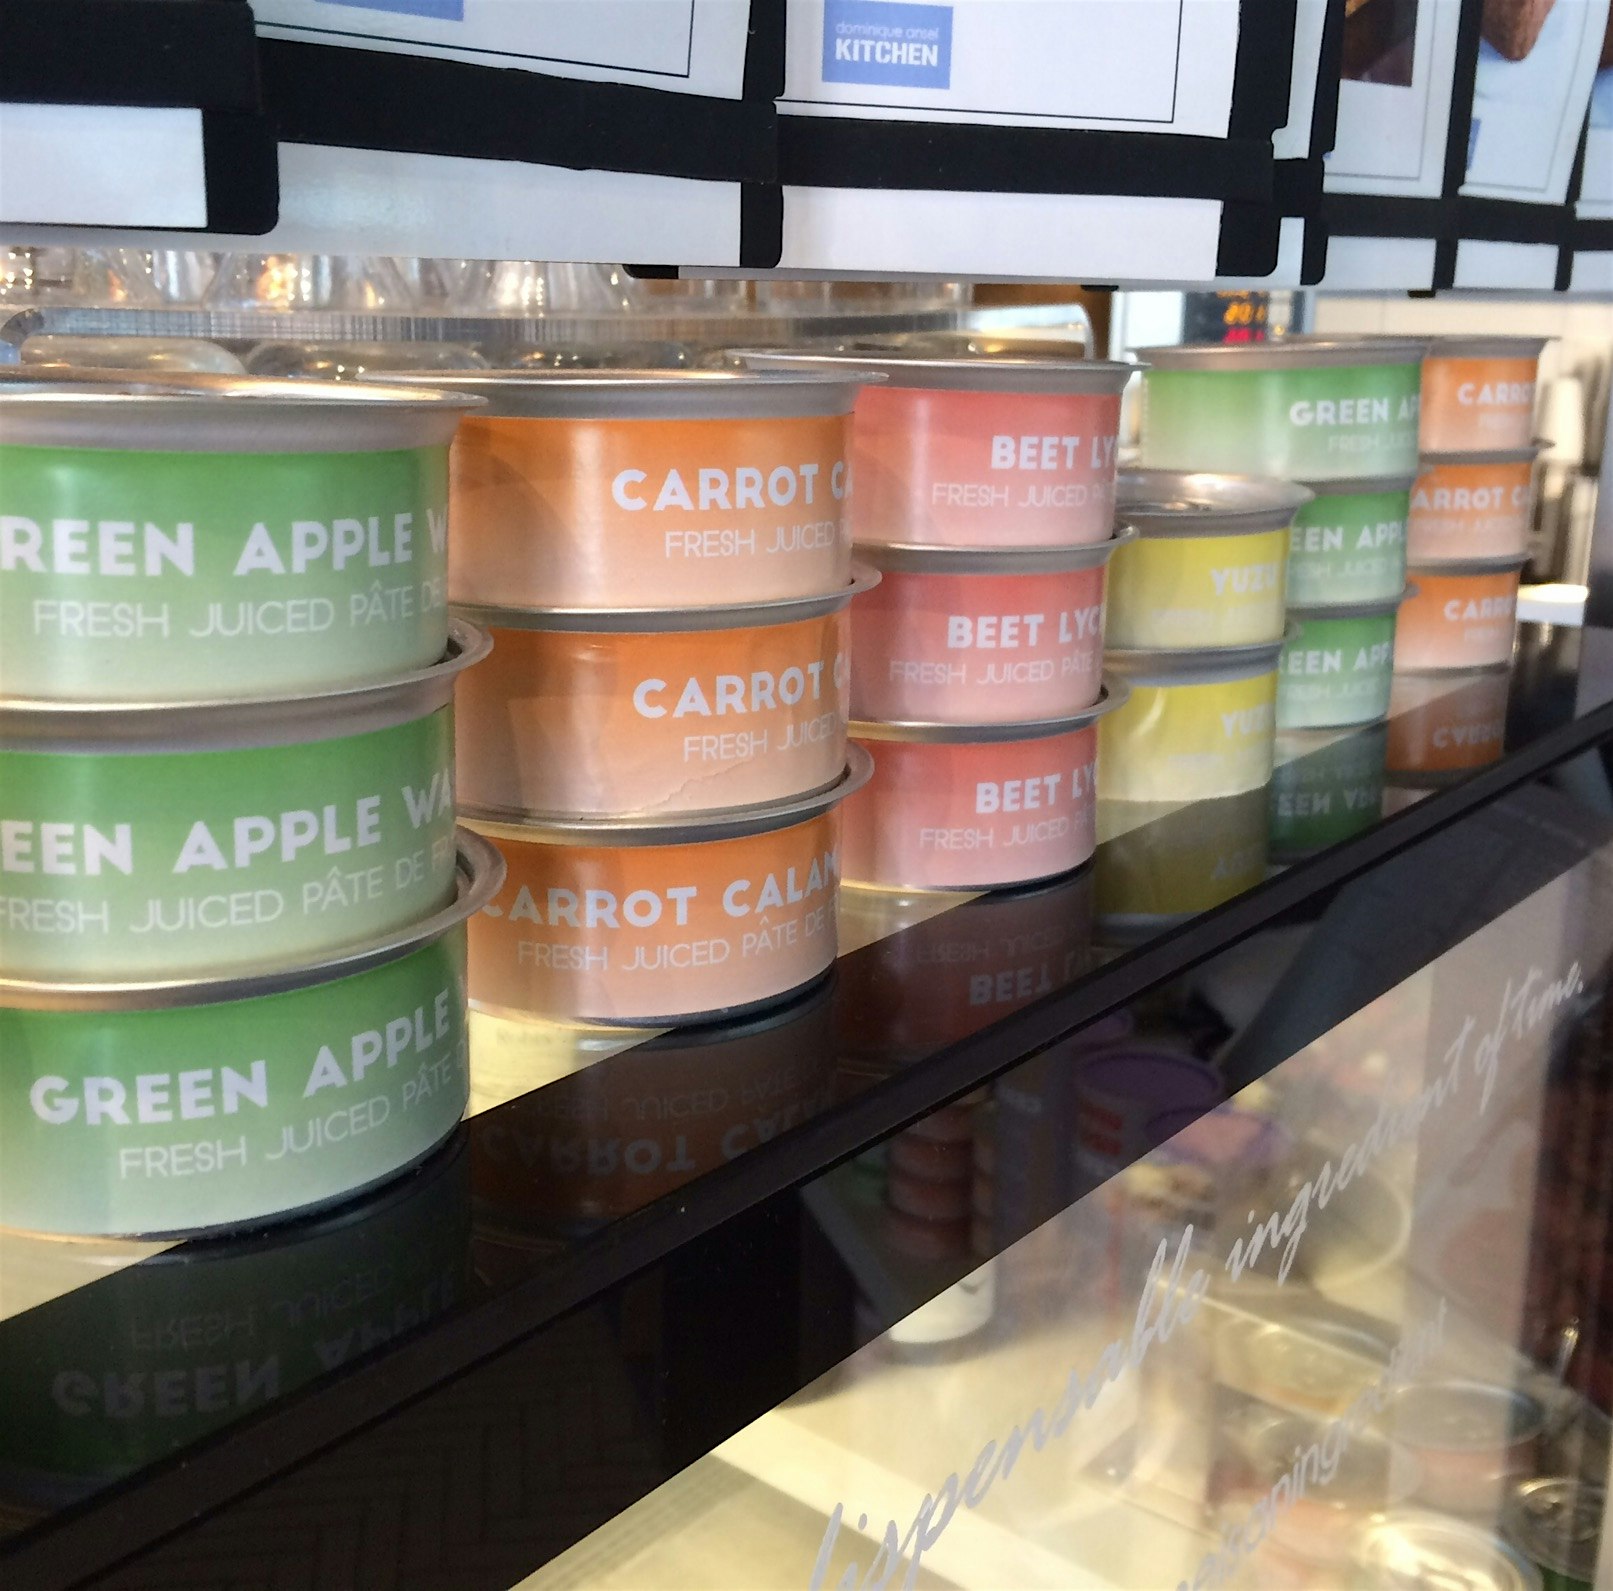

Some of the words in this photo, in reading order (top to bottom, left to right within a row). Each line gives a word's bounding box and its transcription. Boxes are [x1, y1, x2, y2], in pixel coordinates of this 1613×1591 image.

[836, 20, 903, 38] dominique
[906, 26, 939, 40] ansel
[835, 38, 938, 67] KITCHEN
[1289, 397, 1390, 427] GREEN
[990, 435, 1080, 470] BEET
[611, 463, 819, 512] CARROT
[932, 482, 1009, 507] FRESH
[1018, 484, 1087, 508] JUICED
[0, 515, 194, 577] REEN
[233, 511, 413, 576] APPLE
[664, 528, 756, 560] FRESH
[766, 520, 836, 554] JUICED
[33, 598, 170, 639] FRESH
[188, 596, 335, 638] JUICED
[349, 580, 414, 627] PÂTE
[948, 614, 1045, 649] BEET
[632, 660, 825, 719] CARROT
[889, 659, 966, 685] FRESH
[977, 659, 1054, 685] JUICED
[683, 729, 767, 763] FRESH
[975, 773, 1061, 814] BEET
[0, 819, 133, 875] EEN
[172, 795, 382, 873] APPLE
[919, 827, 995, 850] FRESH
[1003, 816, 1069, 847] JUICED
[129, 888, 284, 934] JUICED
[302, 865, 384, 916] PÂTE
[395, 848, 425, 890] DE
[517, 940, 609, 971] FRESH
[622, 938, 729, 972] JUICED
[742, 916, 798, 958] PÂTE
[30, 1059, 269, 1126] GREEN
[303, 988, 450, 1100] APPLE
[118, 1136, 248, 1181] FRESH
[266, 1095, 391, 1161] JUICED
